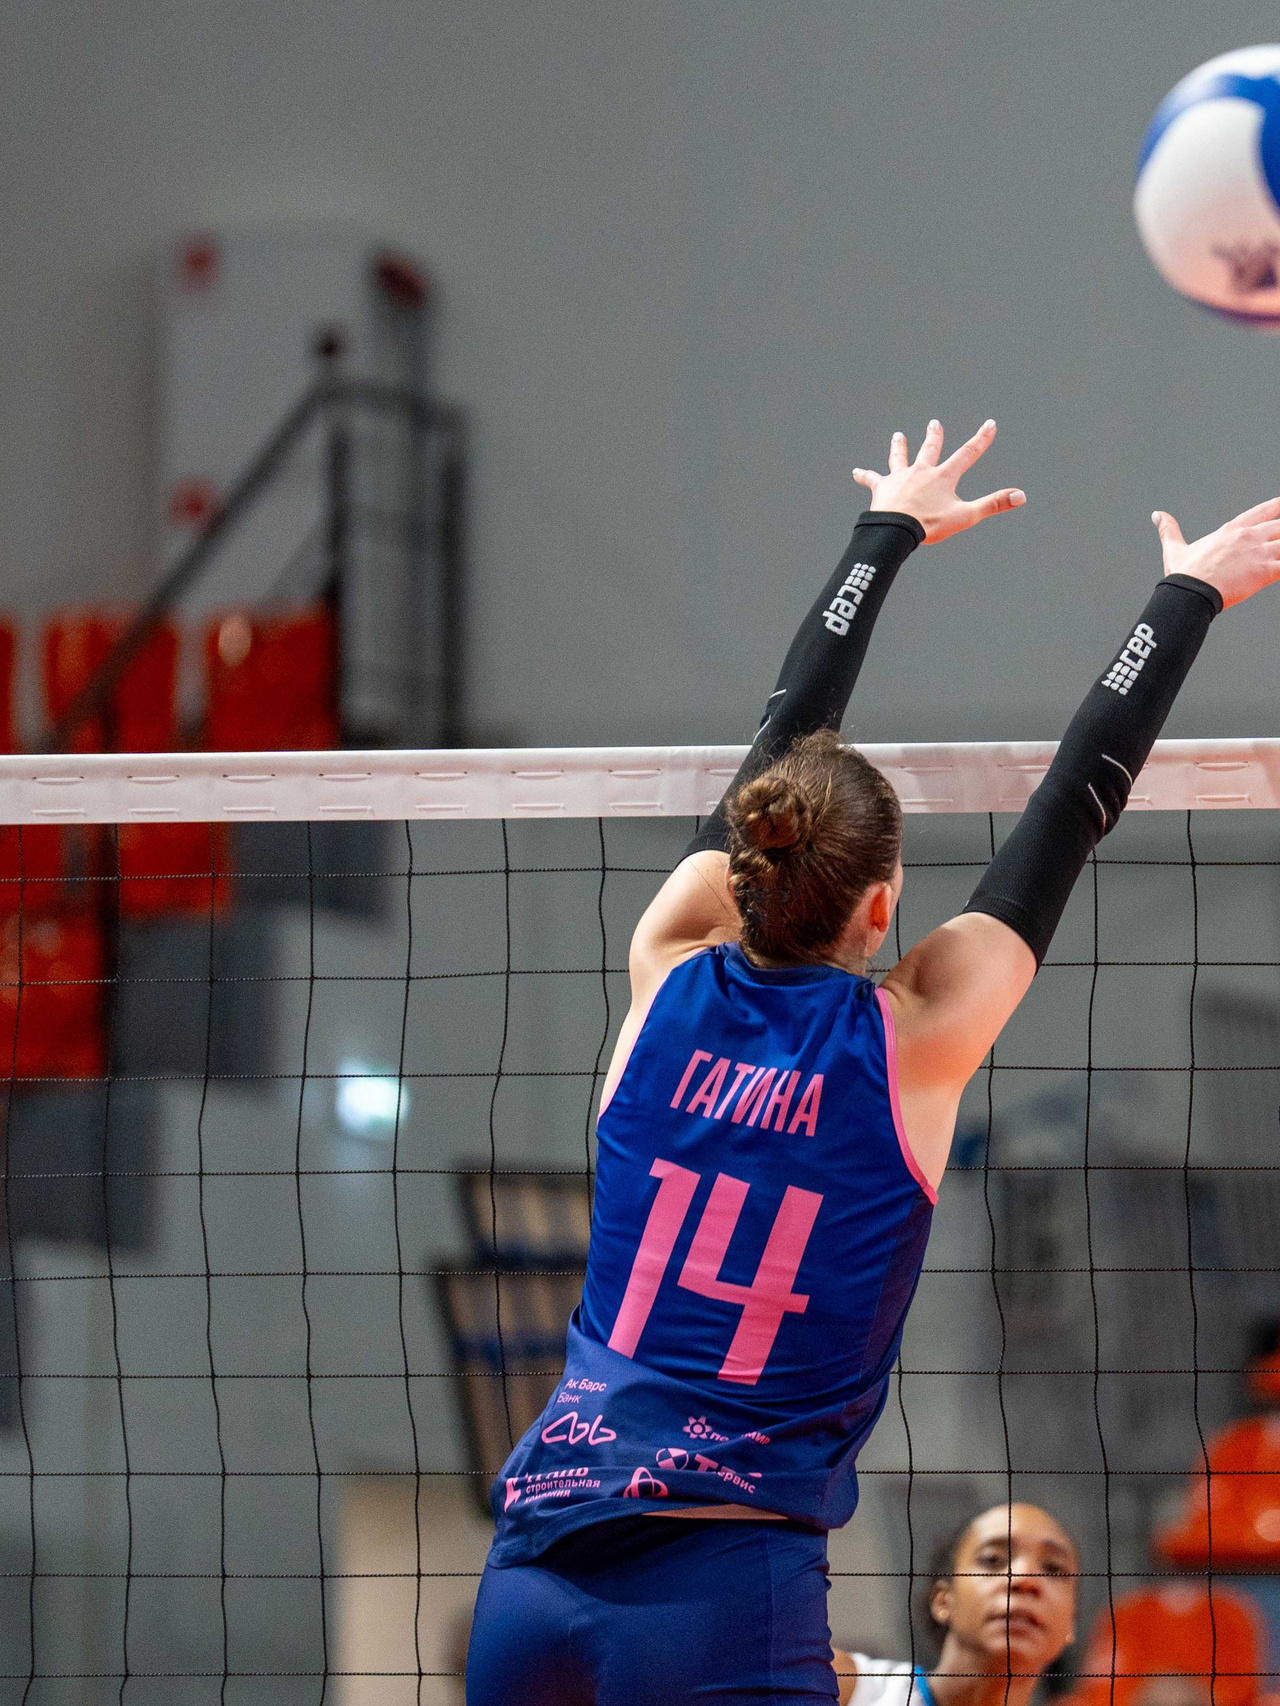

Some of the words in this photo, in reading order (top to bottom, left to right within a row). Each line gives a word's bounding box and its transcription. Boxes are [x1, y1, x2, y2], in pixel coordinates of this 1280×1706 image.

[822, 584, 864, 636] cep
[1119, 622, 1158, 672] cep
[669, 1048, 825, 1138] ГАТИНА
[606, 1156, 825, 1387] 14
[556, 1391, 582, 1404] Банк
[564, 1378, 579, 1390] Ак
[578, 1378, 608, 1394] Барс
[525, 1478, 601, 1495] строительная
